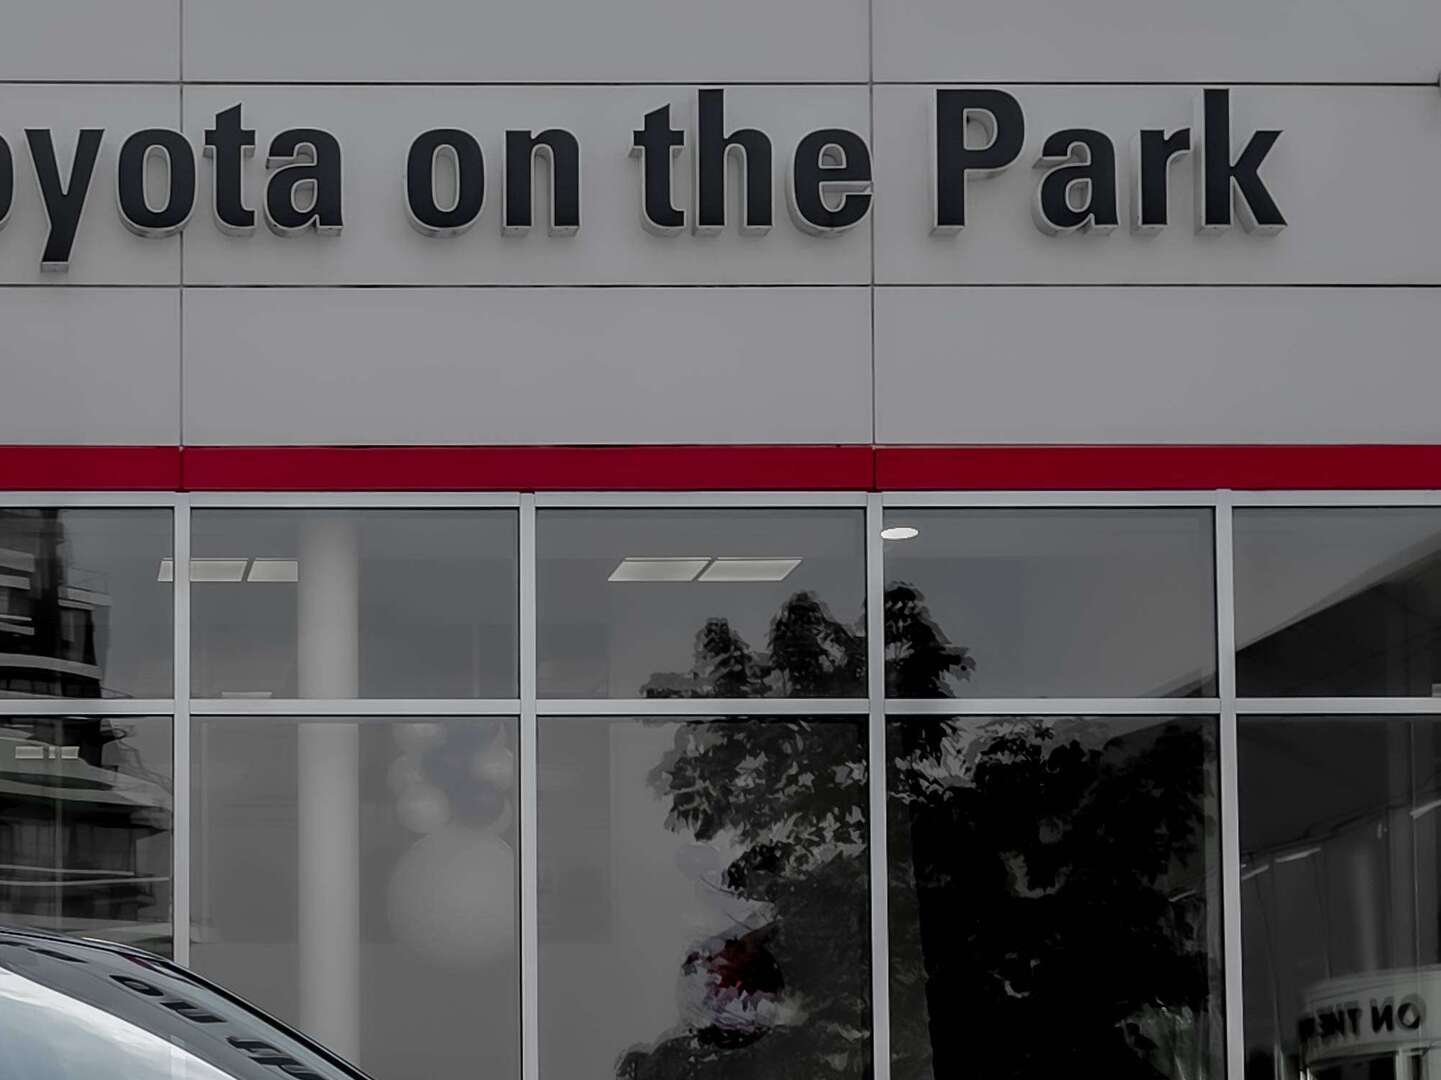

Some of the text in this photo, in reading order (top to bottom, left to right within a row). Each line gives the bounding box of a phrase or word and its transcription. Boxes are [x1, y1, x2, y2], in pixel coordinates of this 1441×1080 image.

[405, 127, 581, 235] on
[632, 87, 874, 234] the
[934, 87, 1290, 232] Park
